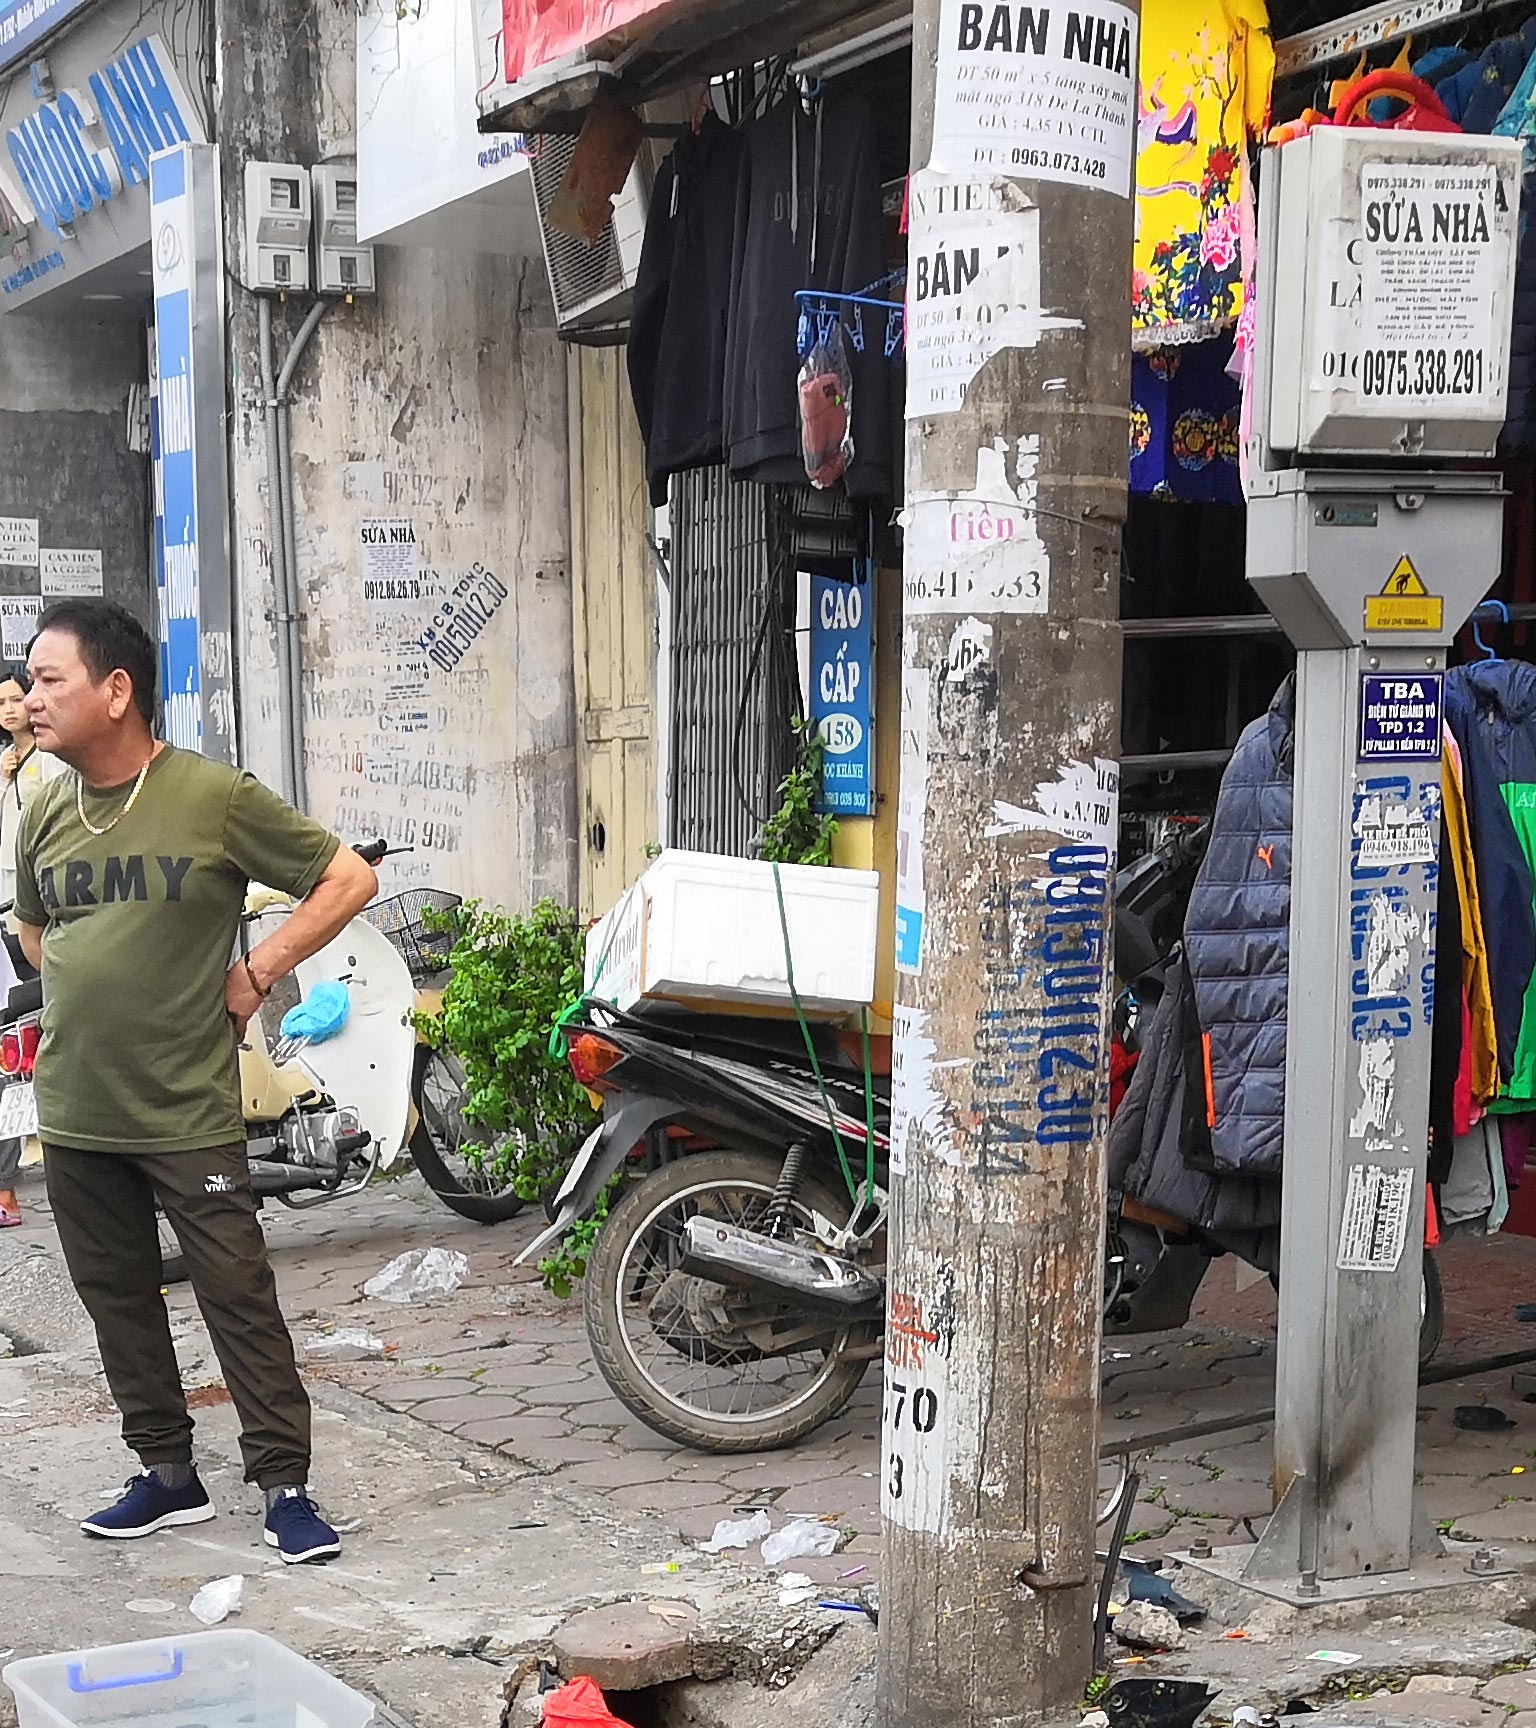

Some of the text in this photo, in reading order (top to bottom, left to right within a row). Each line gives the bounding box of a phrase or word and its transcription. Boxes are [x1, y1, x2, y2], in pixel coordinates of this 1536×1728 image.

[1063, 16, 1131, 79] NHÀ
[88, 37, 197, 187] ANH
[1011, 147, 1106, 179] 0963.073.428
[1366, 190, 1490, 243] SỬA NHÀ
[917, 241, 981, 302] BÁN
[1364, 348, 1483, 396] 0975.338.291
[361, 522, 416, 544] SỬA NHÀ
[364, 579, 420, 600] 0912.86.26.79
[820, 586, 862, 630] CAO
[428, 571, 508, 674] 0915011230
[820, 640, 860, 703] CẤP
[1380, 682, 1425, 700] TBA
[1368, 703, 1387, 721] ĐIỆN
[1378, 721, 1425, 734] TPD 1.2
[825, 720, 854, 747] 158
[836, 762, 864, 779] KHÁNH
[1363, 840, 1430, 853] 0946.918.196
[40, 854, 195, 909] ARMY
